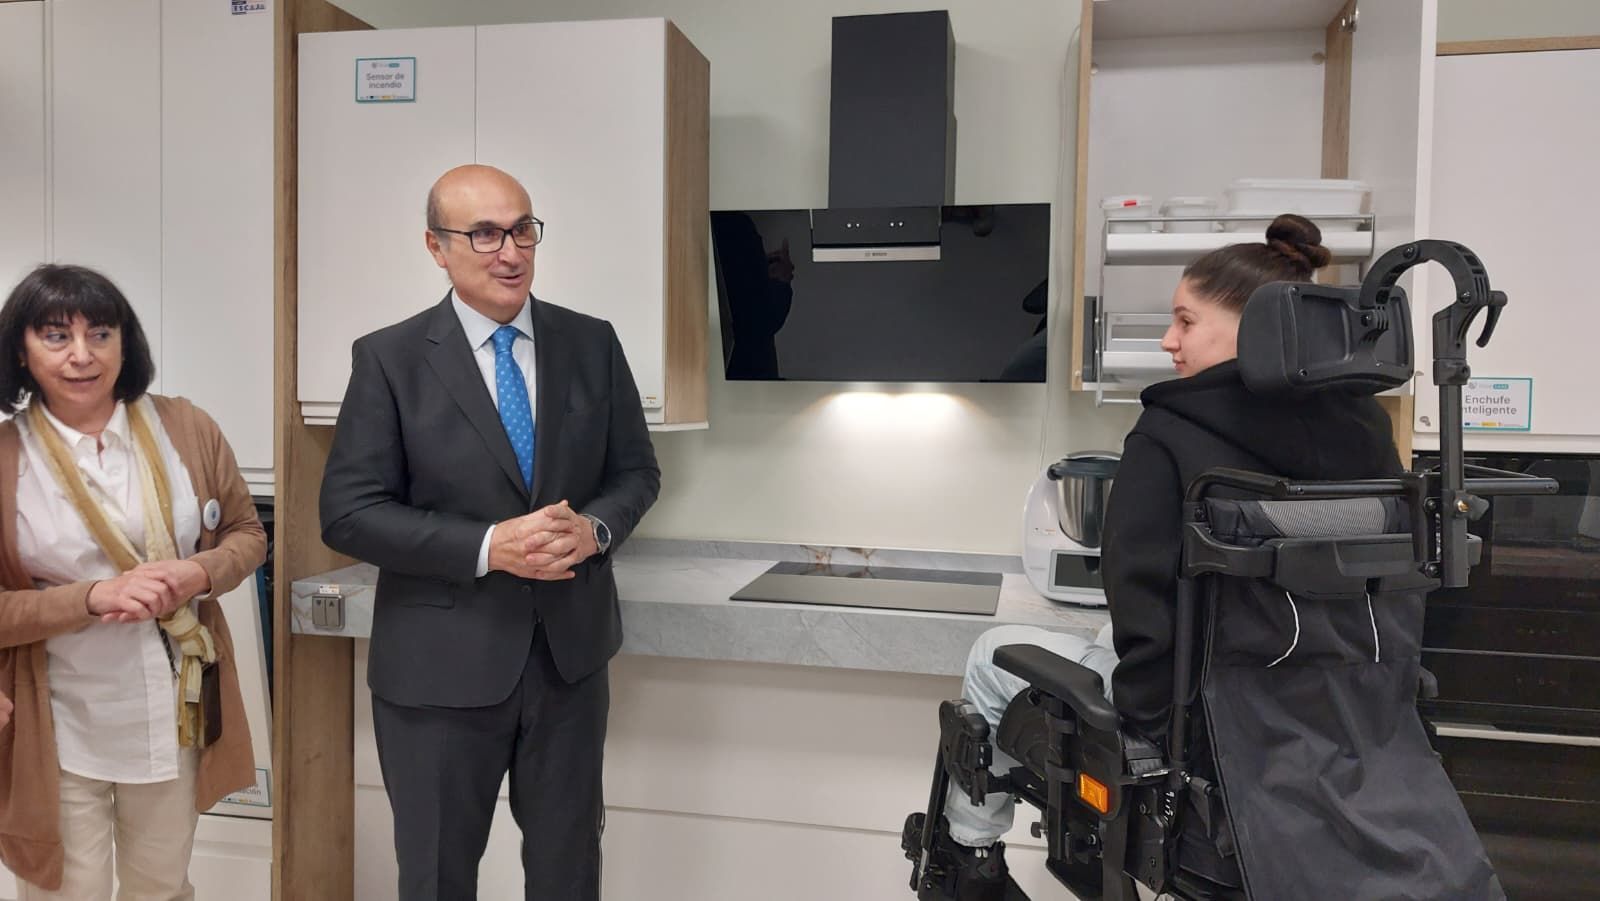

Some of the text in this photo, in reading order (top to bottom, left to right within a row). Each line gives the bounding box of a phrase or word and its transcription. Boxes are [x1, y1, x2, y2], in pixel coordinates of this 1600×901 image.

[366, 73, 393, 81] Sensor
[369, 81, 402, 89] incendio
[1465, 395, 1511, 404] Enchufe
[1463, 405, 1517, 416] nteligente
